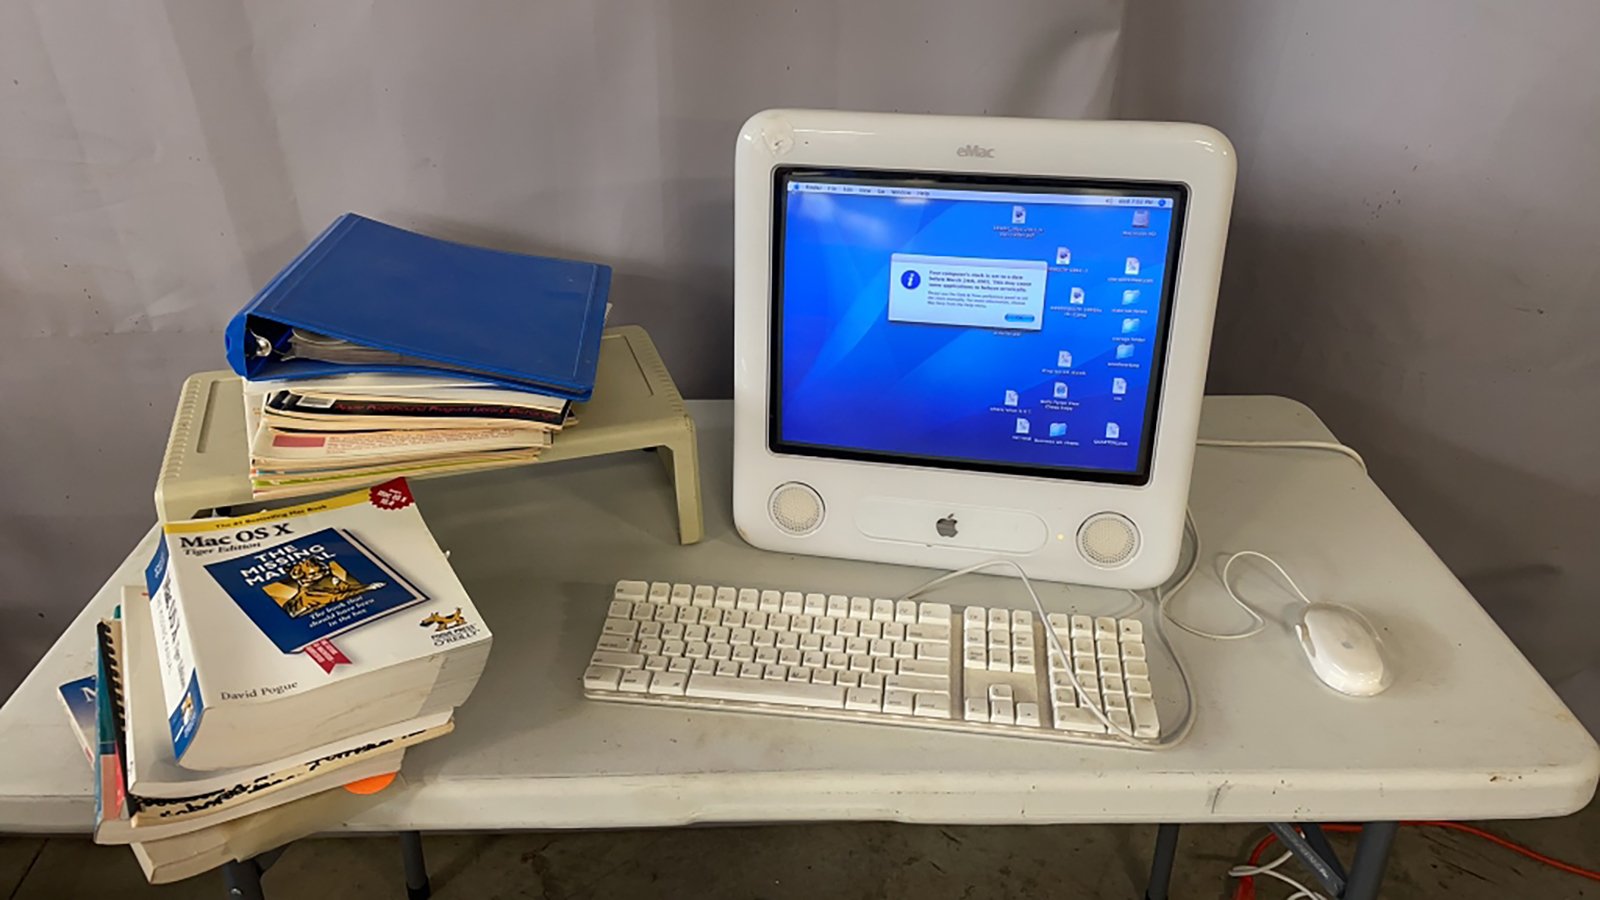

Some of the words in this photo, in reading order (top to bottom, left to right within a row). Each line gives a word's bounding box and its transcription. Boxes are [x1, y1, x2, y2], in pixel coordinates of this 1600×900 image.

[956, 144, 995, 159] eMac
[245, 513, 288, 525] Bestselling
[180, 535, 232, 549] Mac
[235, 527, 269, 543] OS
[273, 523, 294, 537] X
[185, 548, 213, 557] Tiger
[218, 542, 261, 553] Edition
[254, 544, 298, 562] THE
[240, 544, 325, 579] MISSING
[309, 610, 326, 620] The
[326, 602, 347, 613] book
[347, 595, 363, 605] that
[309, 613, 335, 628] should
[338, 615, 351, 623] the
[220, 688, 258, 701] David
[260, 681, 298, 695] Pogue
